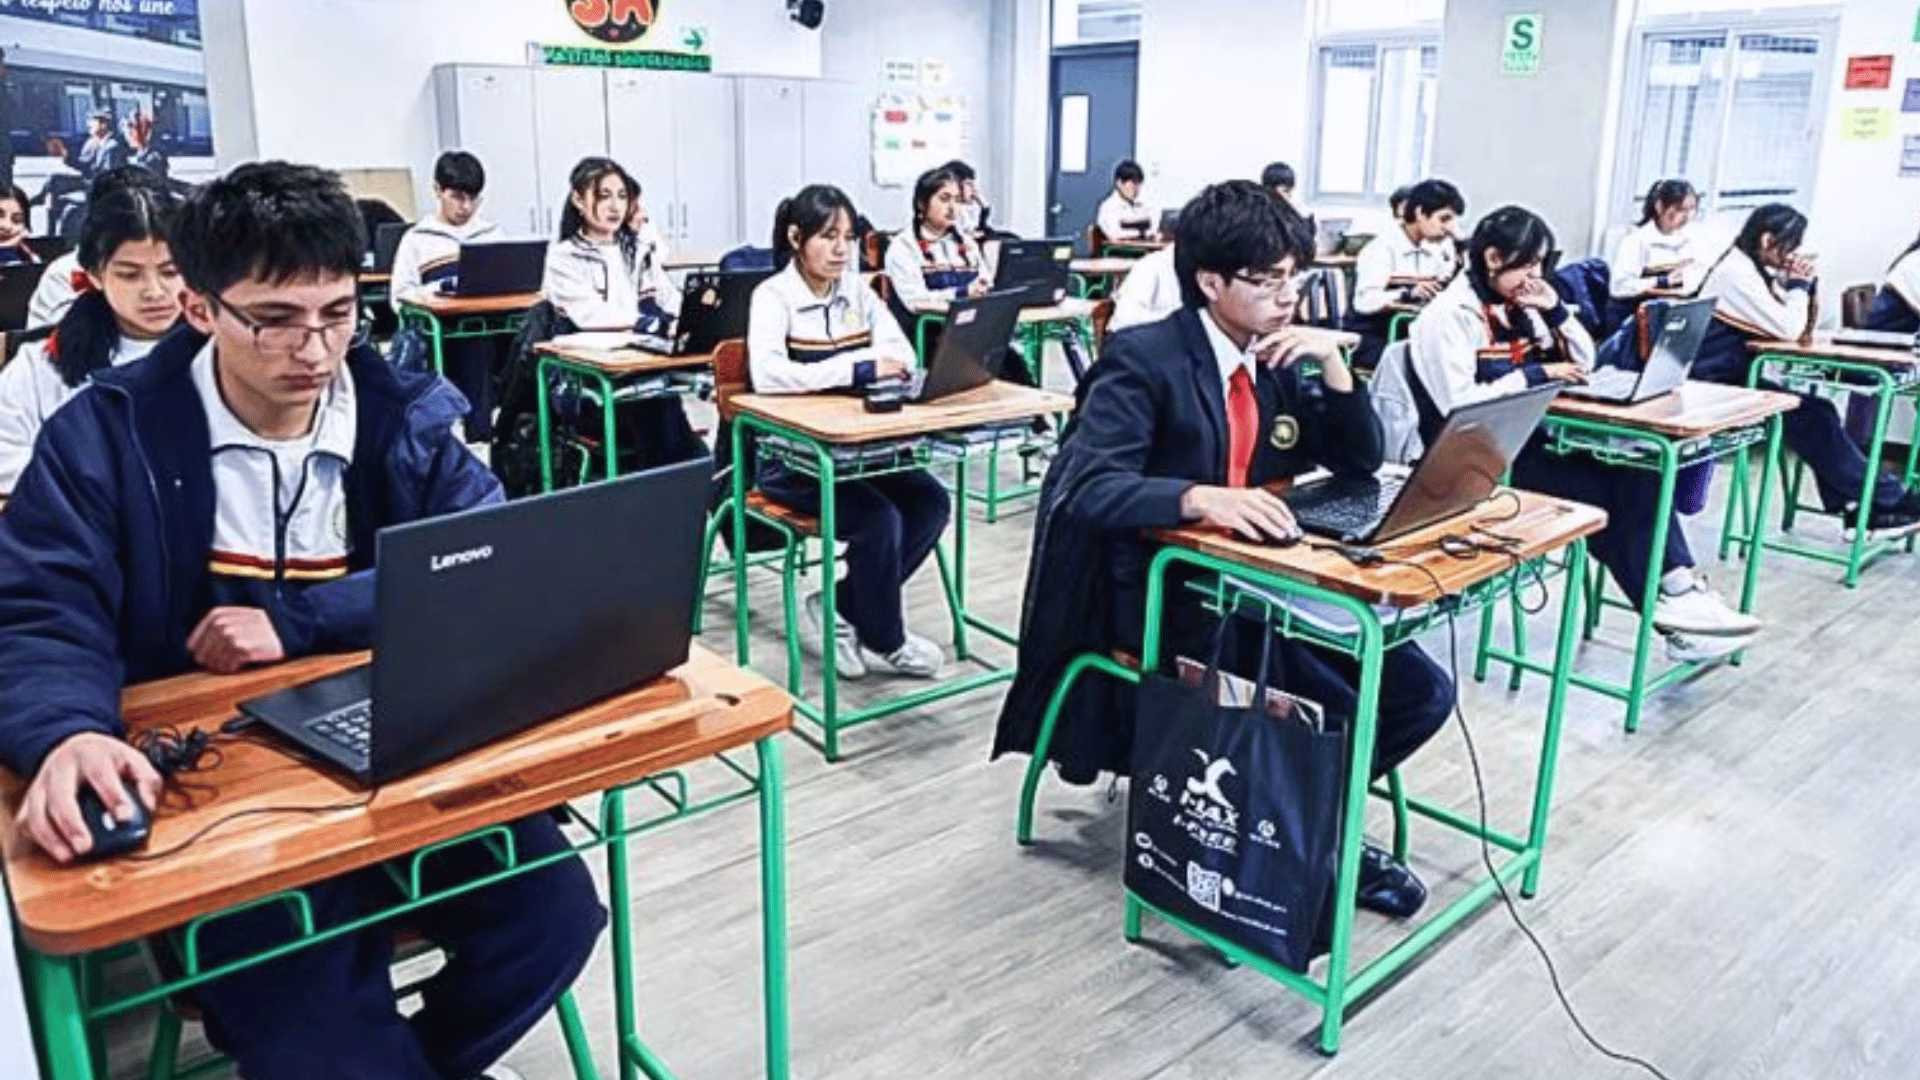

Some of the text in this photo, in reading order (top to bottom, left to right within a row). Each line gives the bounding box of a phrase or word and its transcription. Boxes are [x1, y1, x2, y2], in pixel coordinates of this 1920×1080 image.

[139, 1, 176, 15] une
[1512, 19, 1534, 50] S
[430, 544, 494, 572] Lenovo
